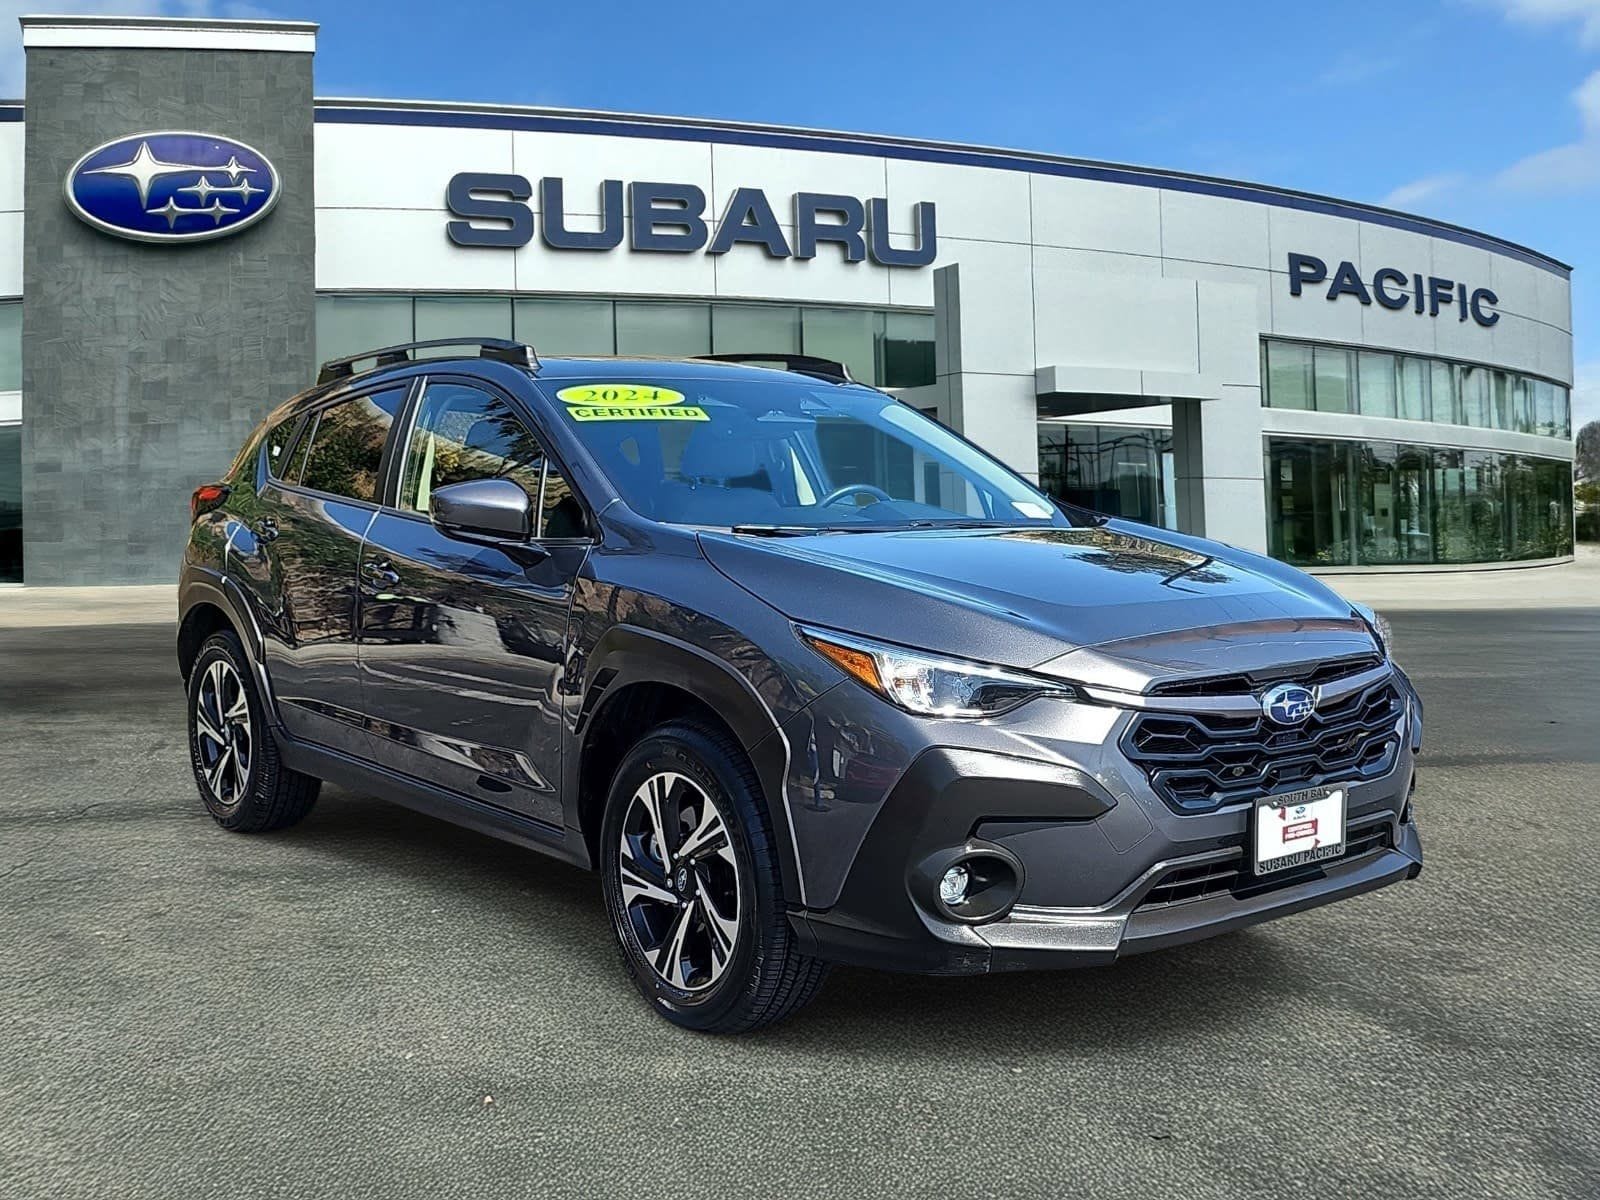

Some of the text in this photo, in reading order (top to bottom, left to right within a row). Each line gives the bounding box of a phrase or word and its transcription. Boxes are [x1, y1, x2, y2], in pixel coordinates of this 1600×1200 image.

[446, 171, 938, 269] SUBARU
[1287, 252, 1501, 328] PACIFIC
[583, 389, 660, 403] 2024
[574, 407, 699, 418] CERTIFIED
[1278, 791, 1308, 804] SOUTH
[1258, 843, 1342, 873] SUBARU PACIFIC
